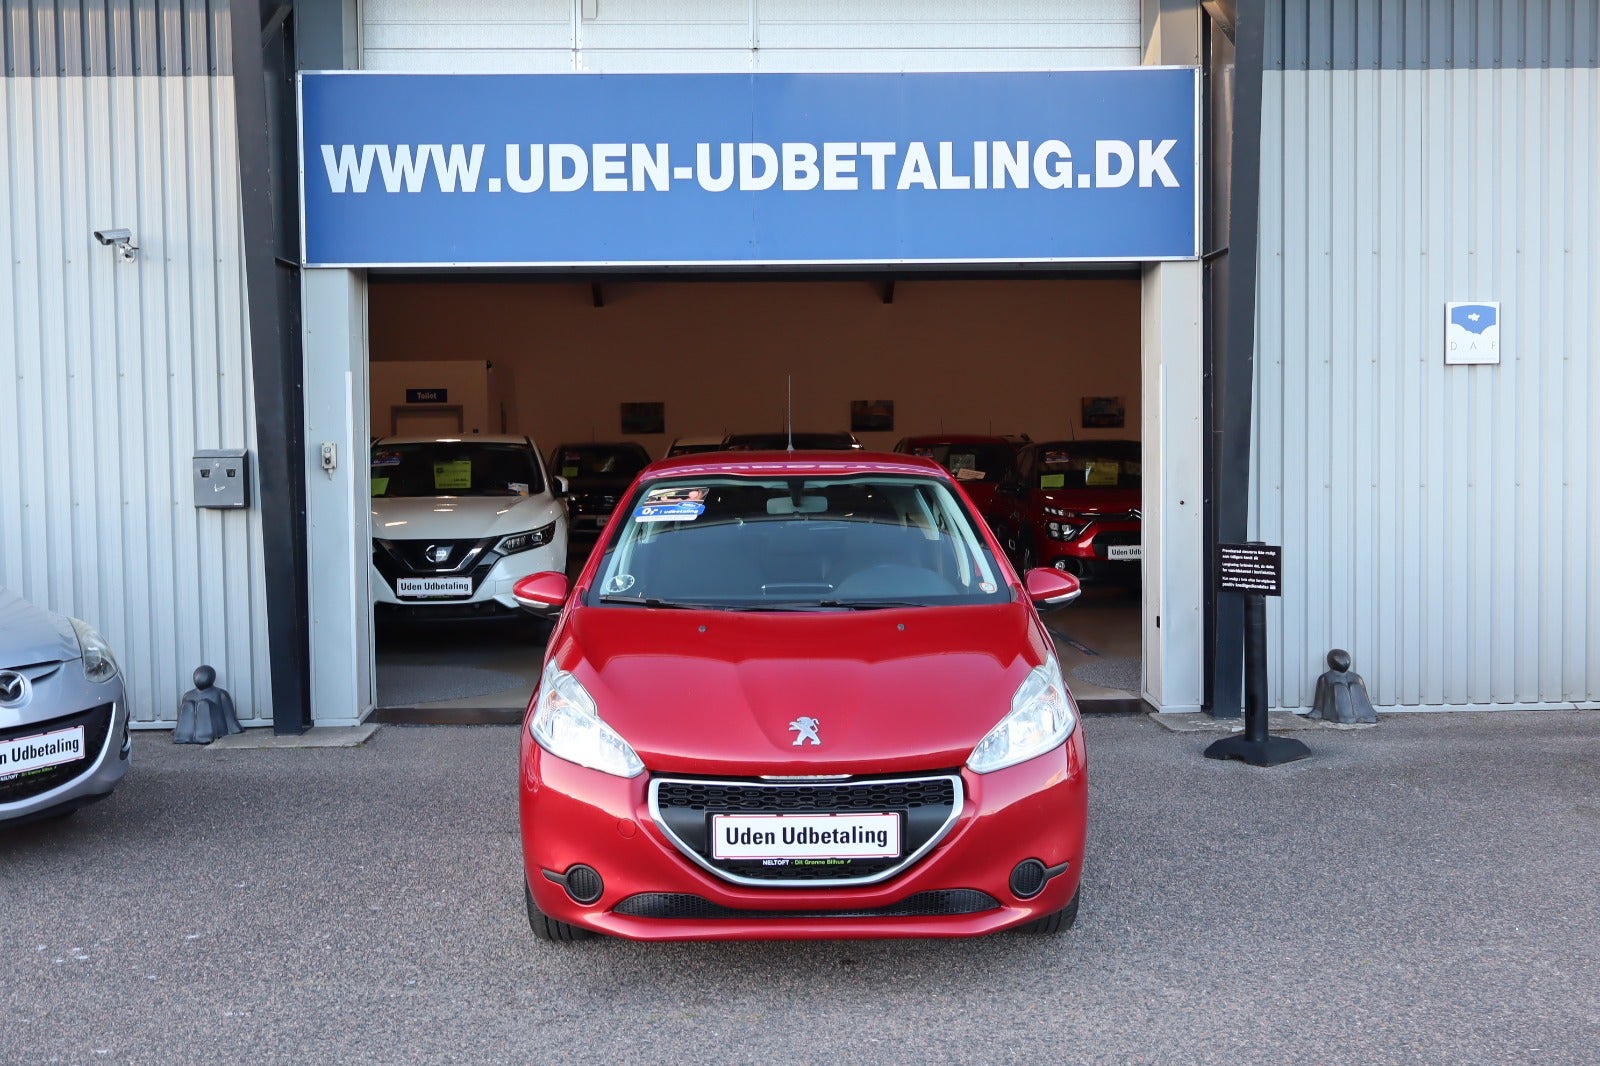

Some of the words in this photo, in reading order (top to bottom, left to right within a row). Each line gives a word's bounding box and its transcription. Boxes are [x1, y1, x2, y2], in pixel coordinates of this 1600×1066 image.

[320, 139, 1180, 193] WWW.UDEN-UDBETALING.DK
[416, 391, 437, 400] Toilet
[400, 582, 422, 591] Uden
[424, 582, 469, 591] Udbetaling
[11, 738, 80, 763] Udbetaling
[726, 827, 775, 845] Uden
[782, 825, 888, 848] Udbetaling
